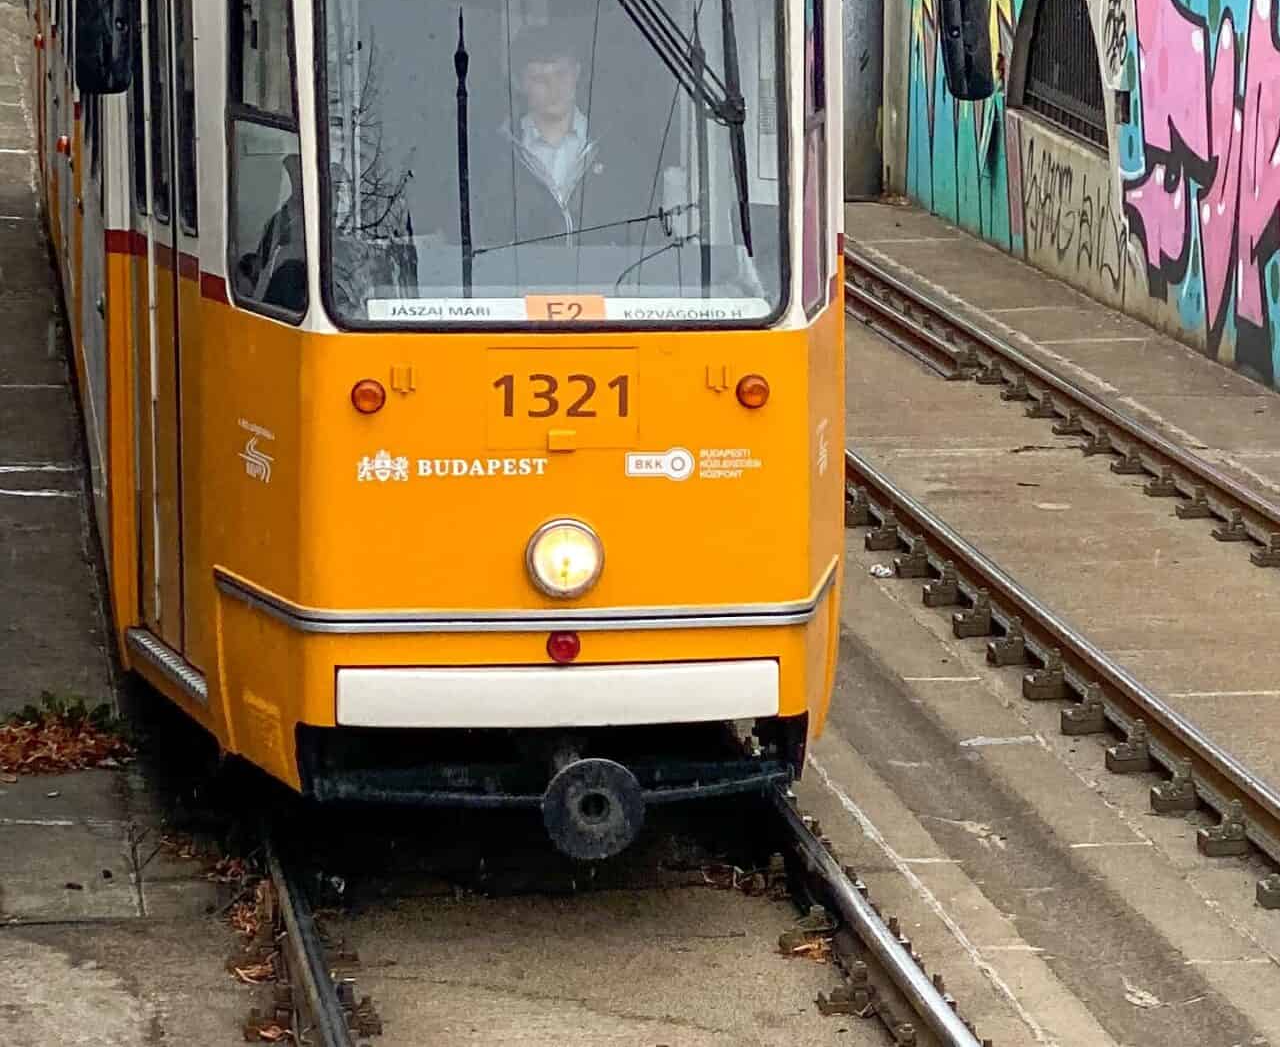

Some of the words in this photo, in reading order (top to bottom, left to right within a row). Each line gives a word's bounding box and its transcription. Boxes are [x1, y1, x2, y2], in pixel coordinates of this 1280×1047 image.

[449, 304, 491, 317] MARI
[493, 373, 629, 418] 1321
[417, 457, 548, 478] BUDAPEST
[634, 459, 664, 470] BKK
